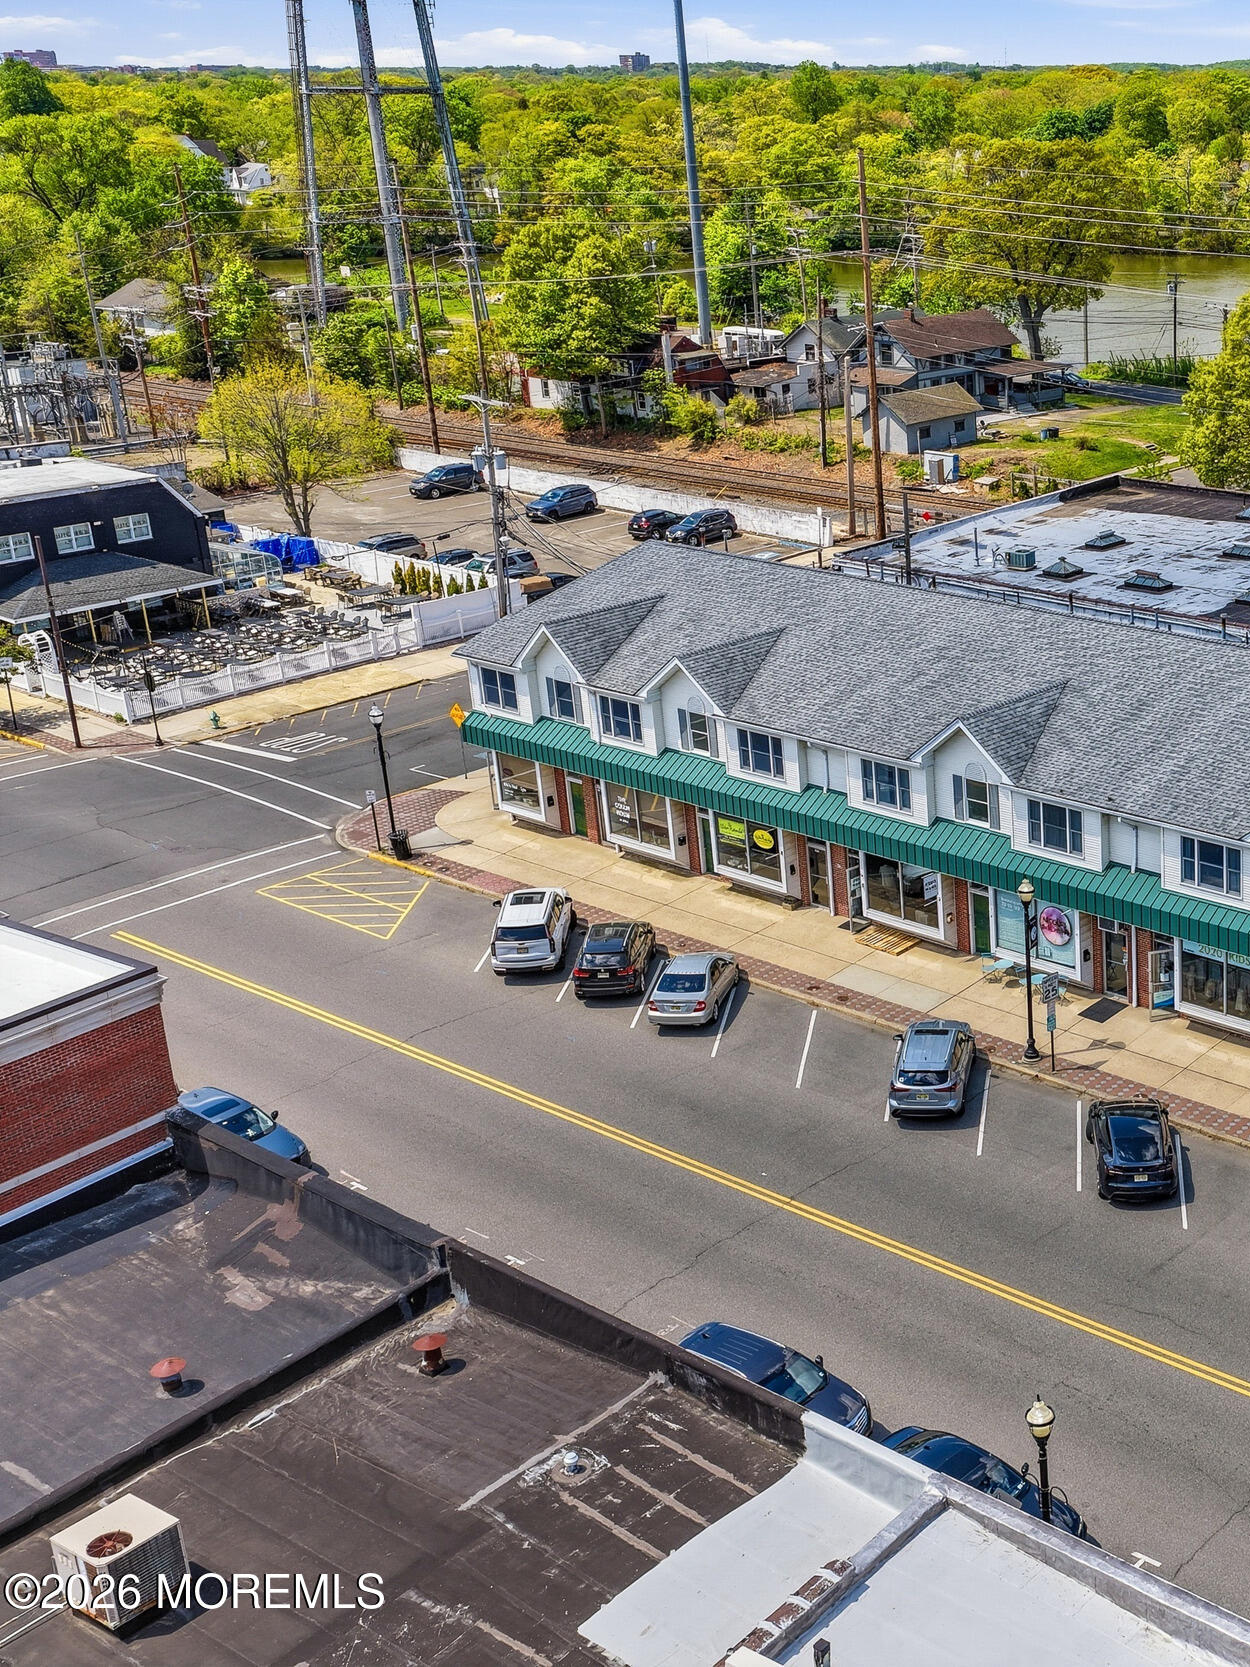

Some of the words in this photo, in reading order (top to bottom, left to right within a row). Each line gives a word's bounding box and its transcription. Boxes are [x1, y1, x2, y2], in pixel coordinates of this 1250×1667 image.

[1199, 944, 1223, 958] 2020
[1229, 953, 1250, 966] KIDS
[1044, 985, 1058, 1000] 25
